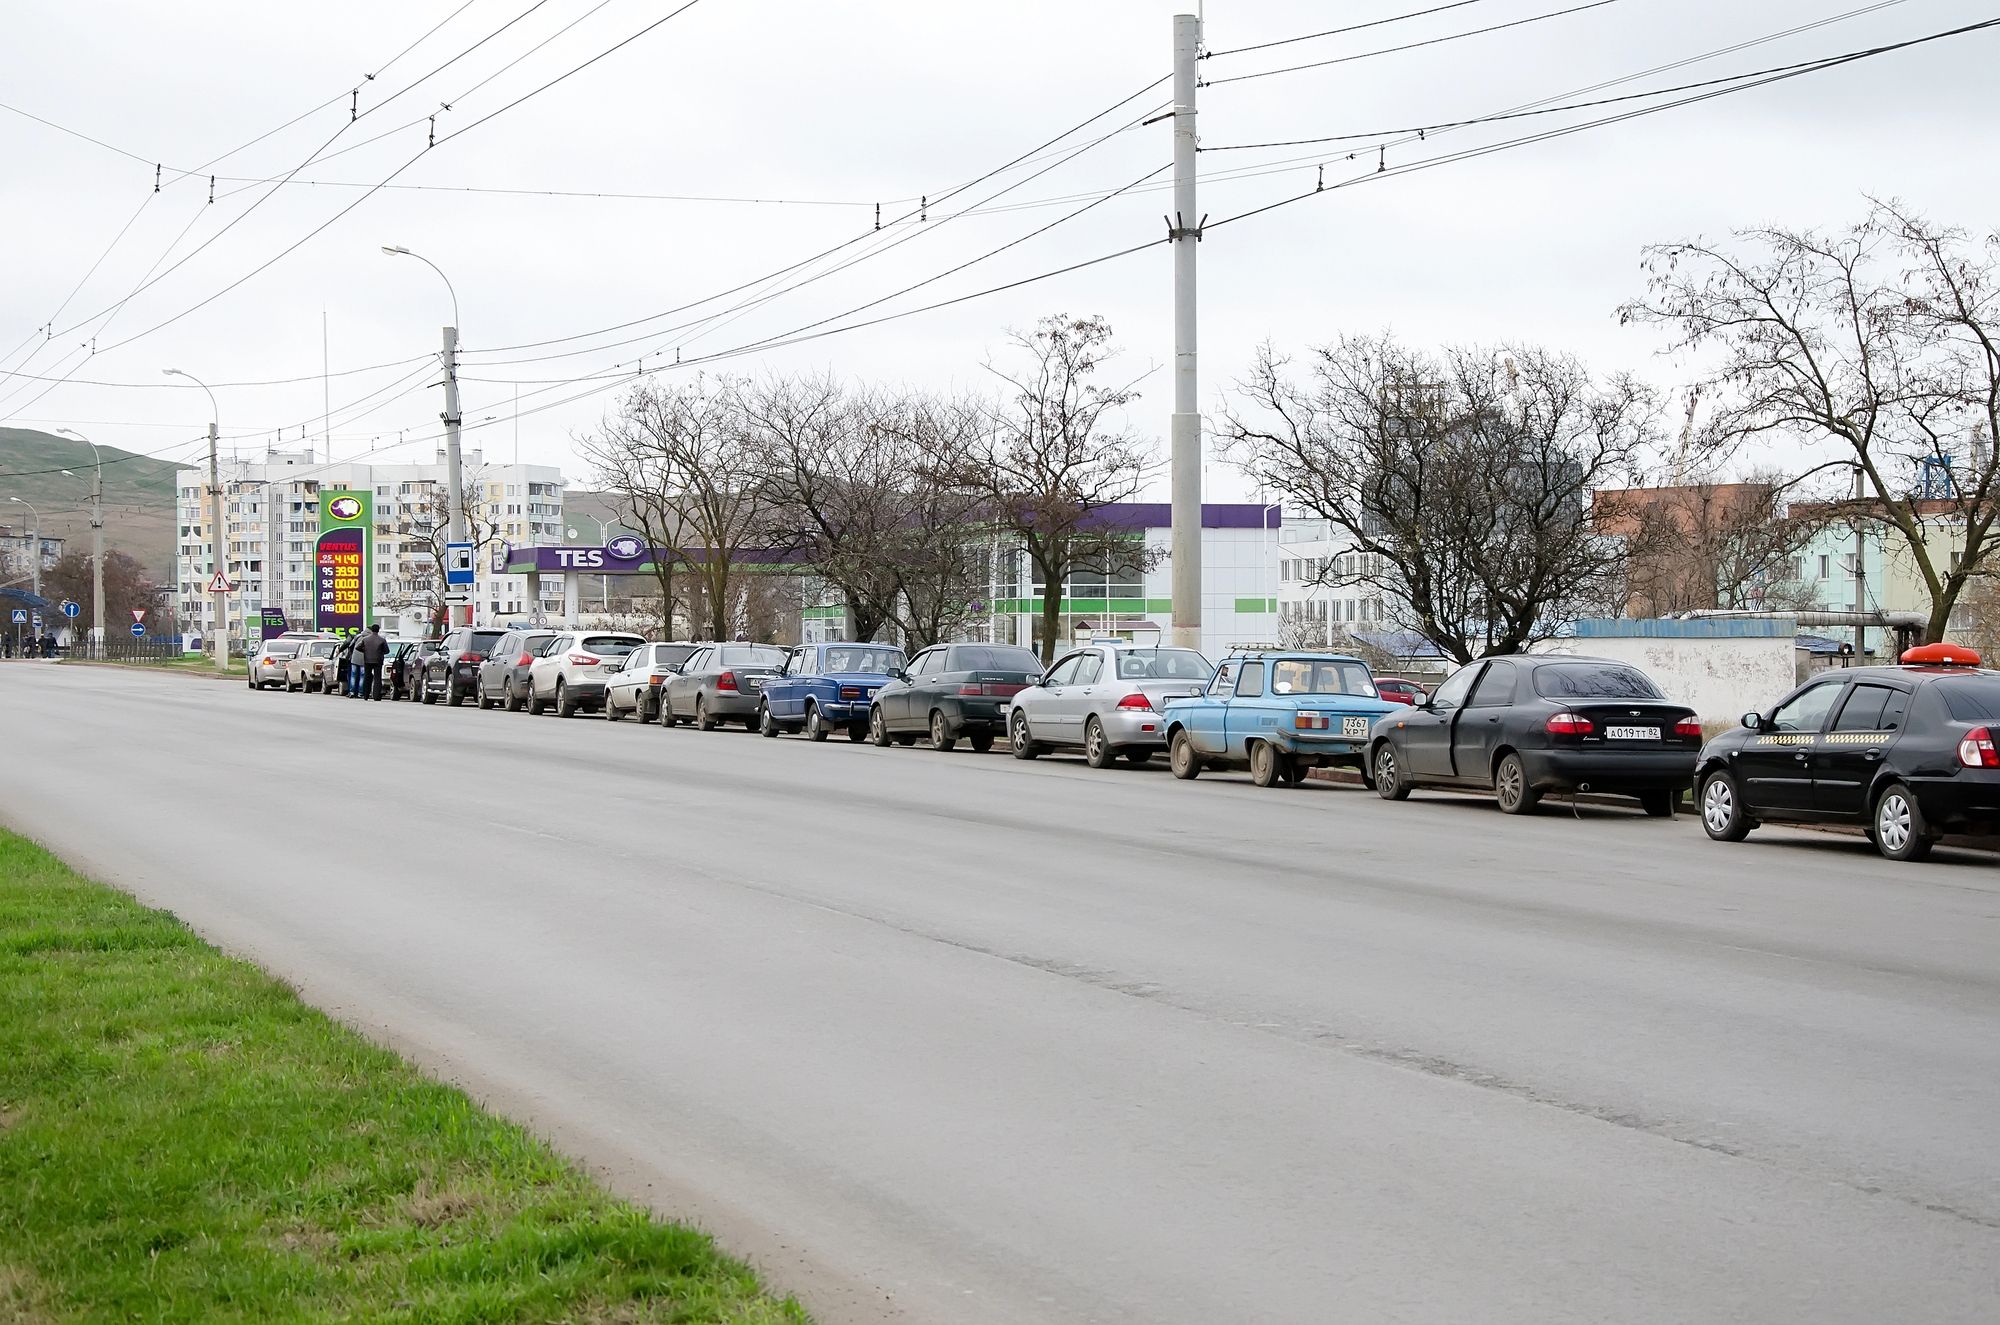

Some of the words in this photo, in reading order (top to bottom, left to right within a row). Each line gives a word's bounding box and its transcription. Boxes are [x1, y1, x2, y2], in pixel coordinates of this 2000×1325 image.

[555, 550, 604, 568] TES
[322, 567, 333, 576] 95
[322, 579, 333, 588] 92
[264, 617, 284, 626] TES
[1345, 718, 1366, 728] 7367
[1648, 728, 1658, 736] 82
